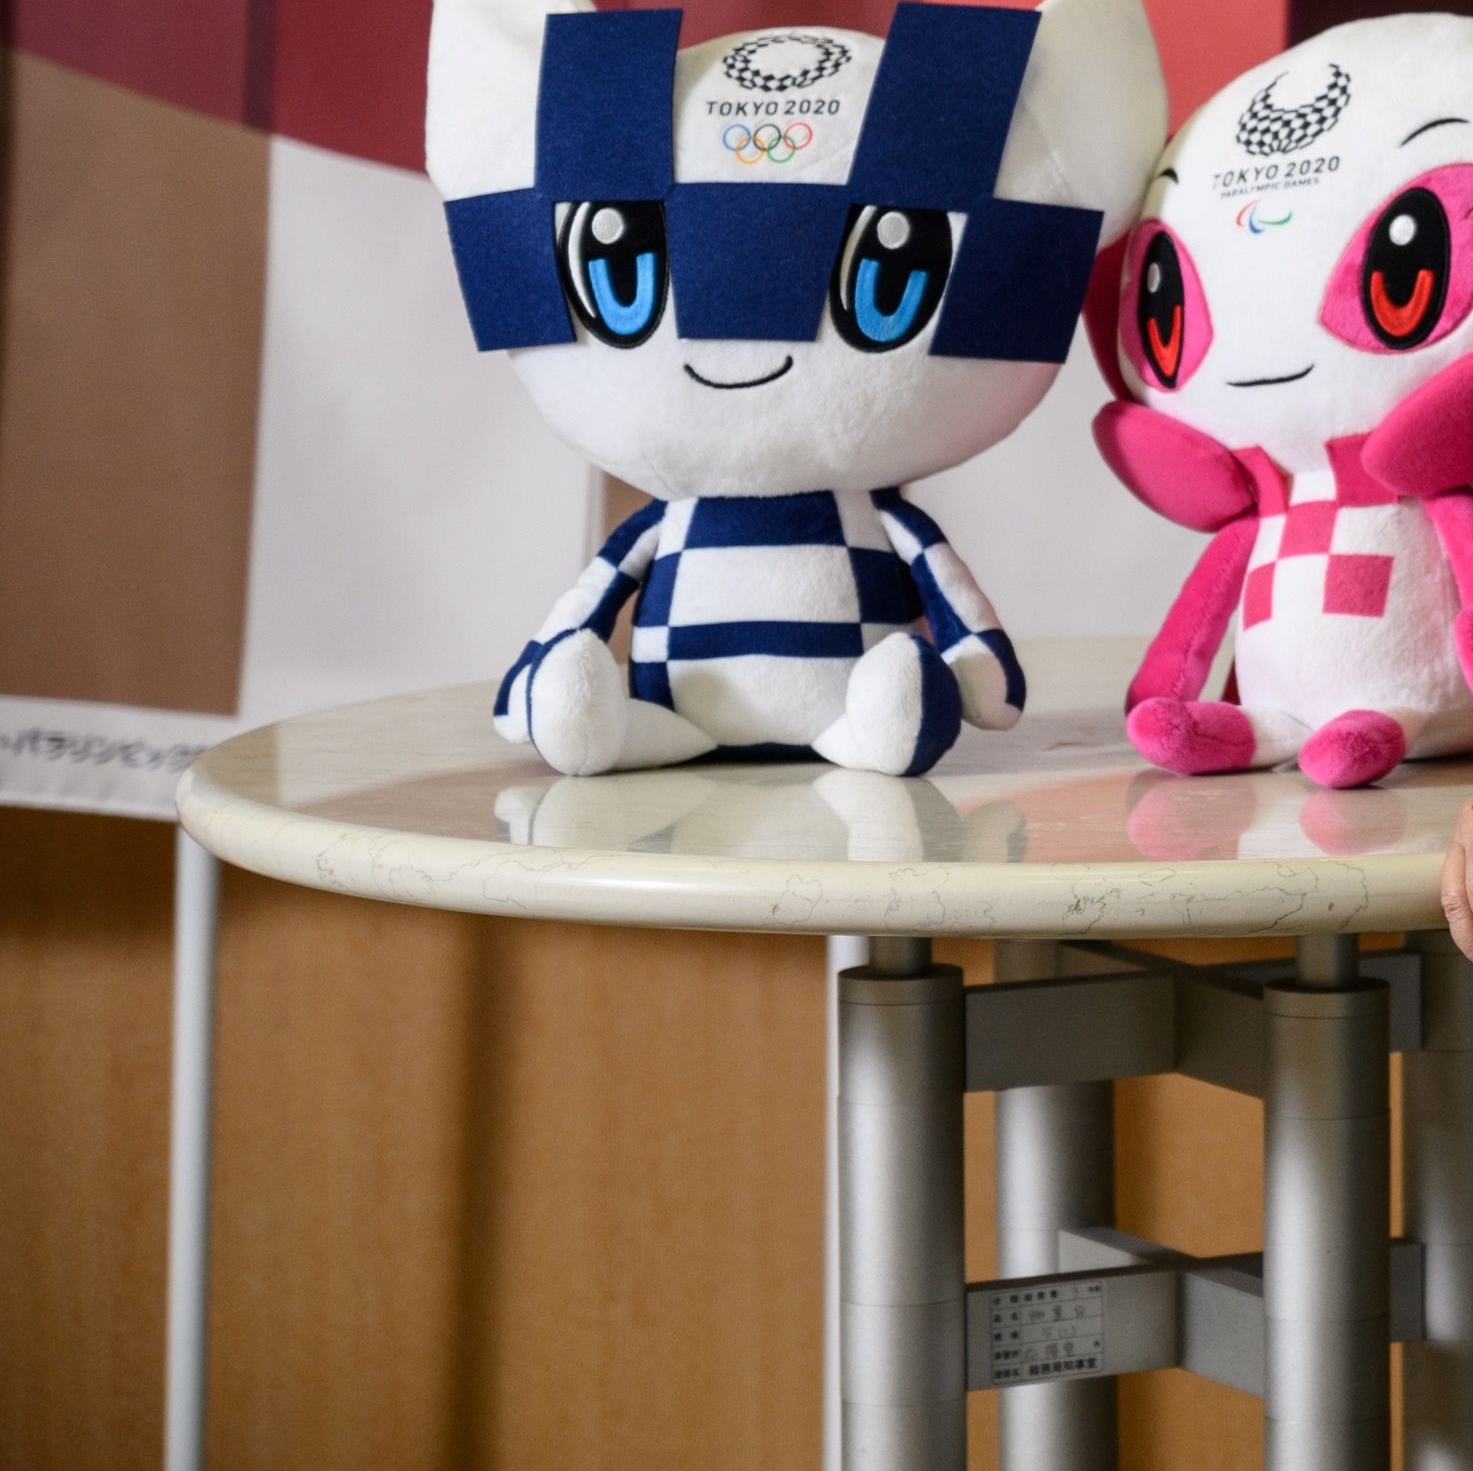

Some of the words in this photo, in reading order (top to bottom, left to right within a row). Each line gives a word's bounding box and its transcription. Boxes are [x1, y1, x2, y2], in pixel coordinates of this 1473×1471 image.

[706, 101, 779, 116] TOKYO
[783, 99, 841, 115] 2020
[1212, 164, 1279, 190] TOKYO
[1284, 155, 1341, 179] 2020
